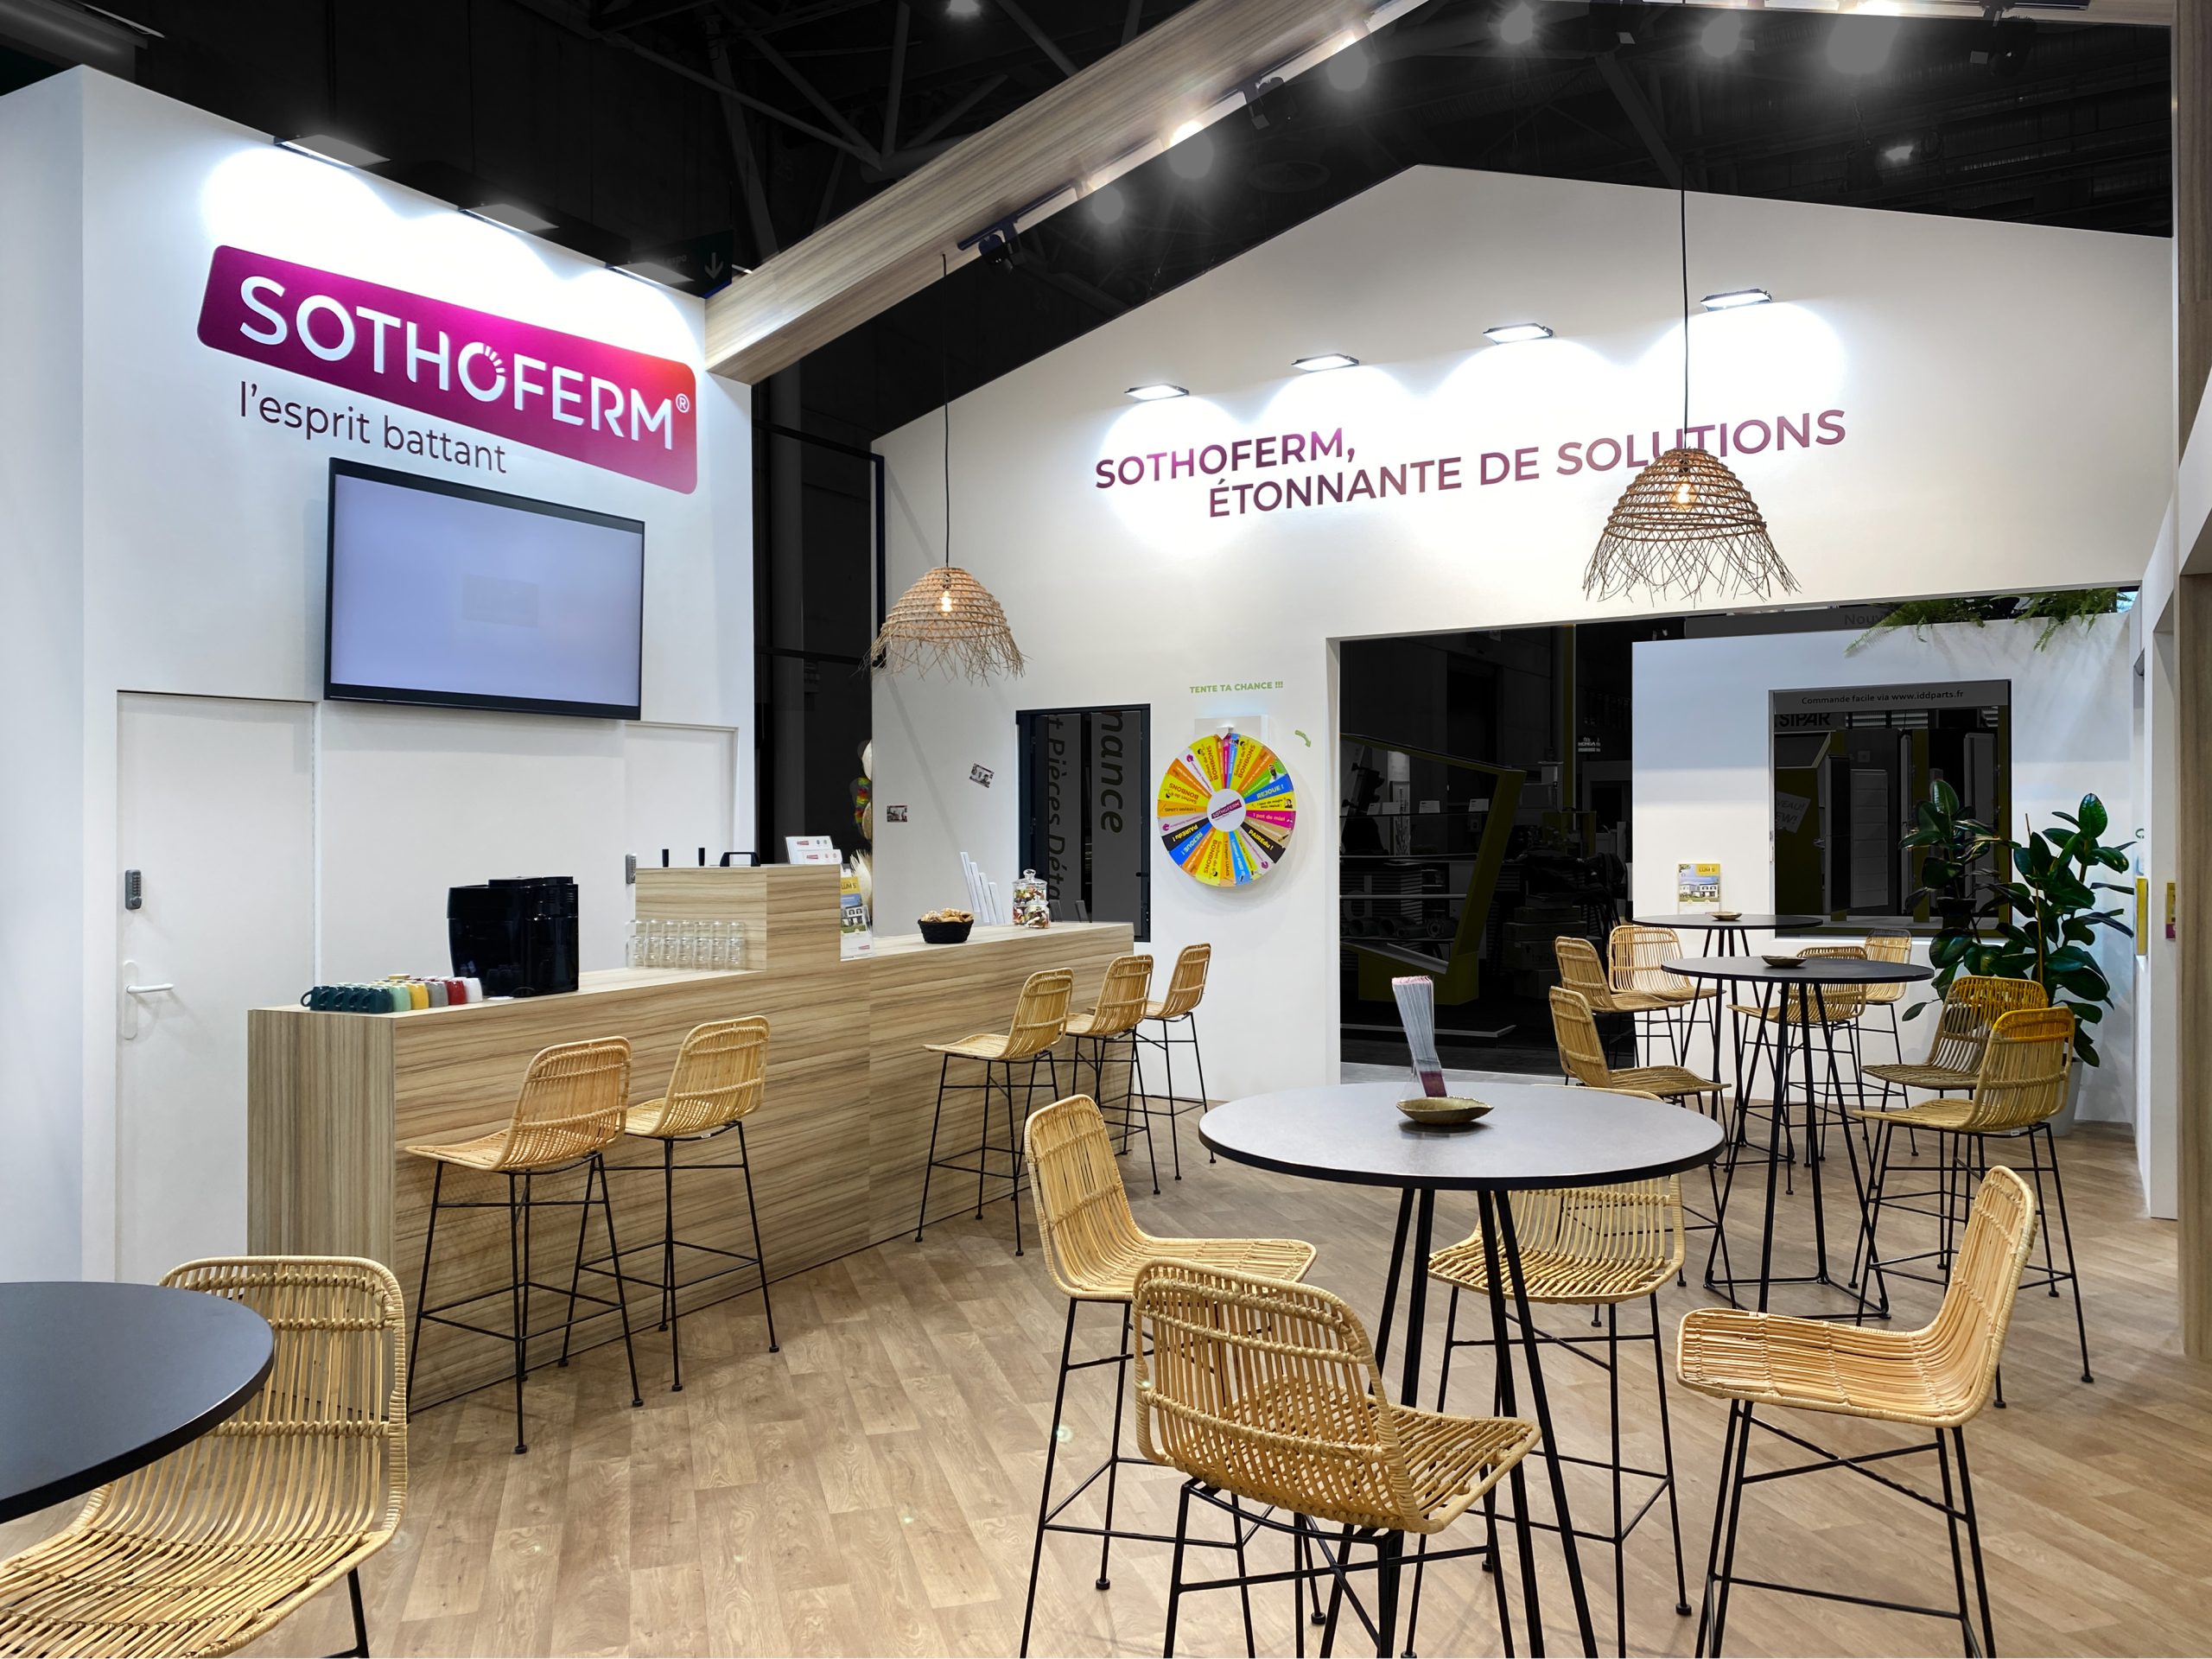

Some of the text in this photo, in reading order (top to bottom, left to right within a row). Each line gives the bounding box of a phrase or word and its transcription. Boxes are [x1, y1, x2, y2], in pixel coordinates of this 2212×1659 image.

[384, 415, 507, 474] battant
[1095, 427, 1356, 489] SOTHOFERM,
[1209, 409, 1847, 518] ÉTONNANTE DE SOLUTIONS
[1189, 685, 1218, 694] TENTE
[1219, 683, 1232, 692] TA
[1234, 681, 1273, 691] CHANCE
[1802, 696, 1850, 705] Commande
[1852, 693, 1875, 702] facile
[1891, 690, 1964, 701] www.iddparts.fr
[1776, 713, 1830, 728] SIPAR
